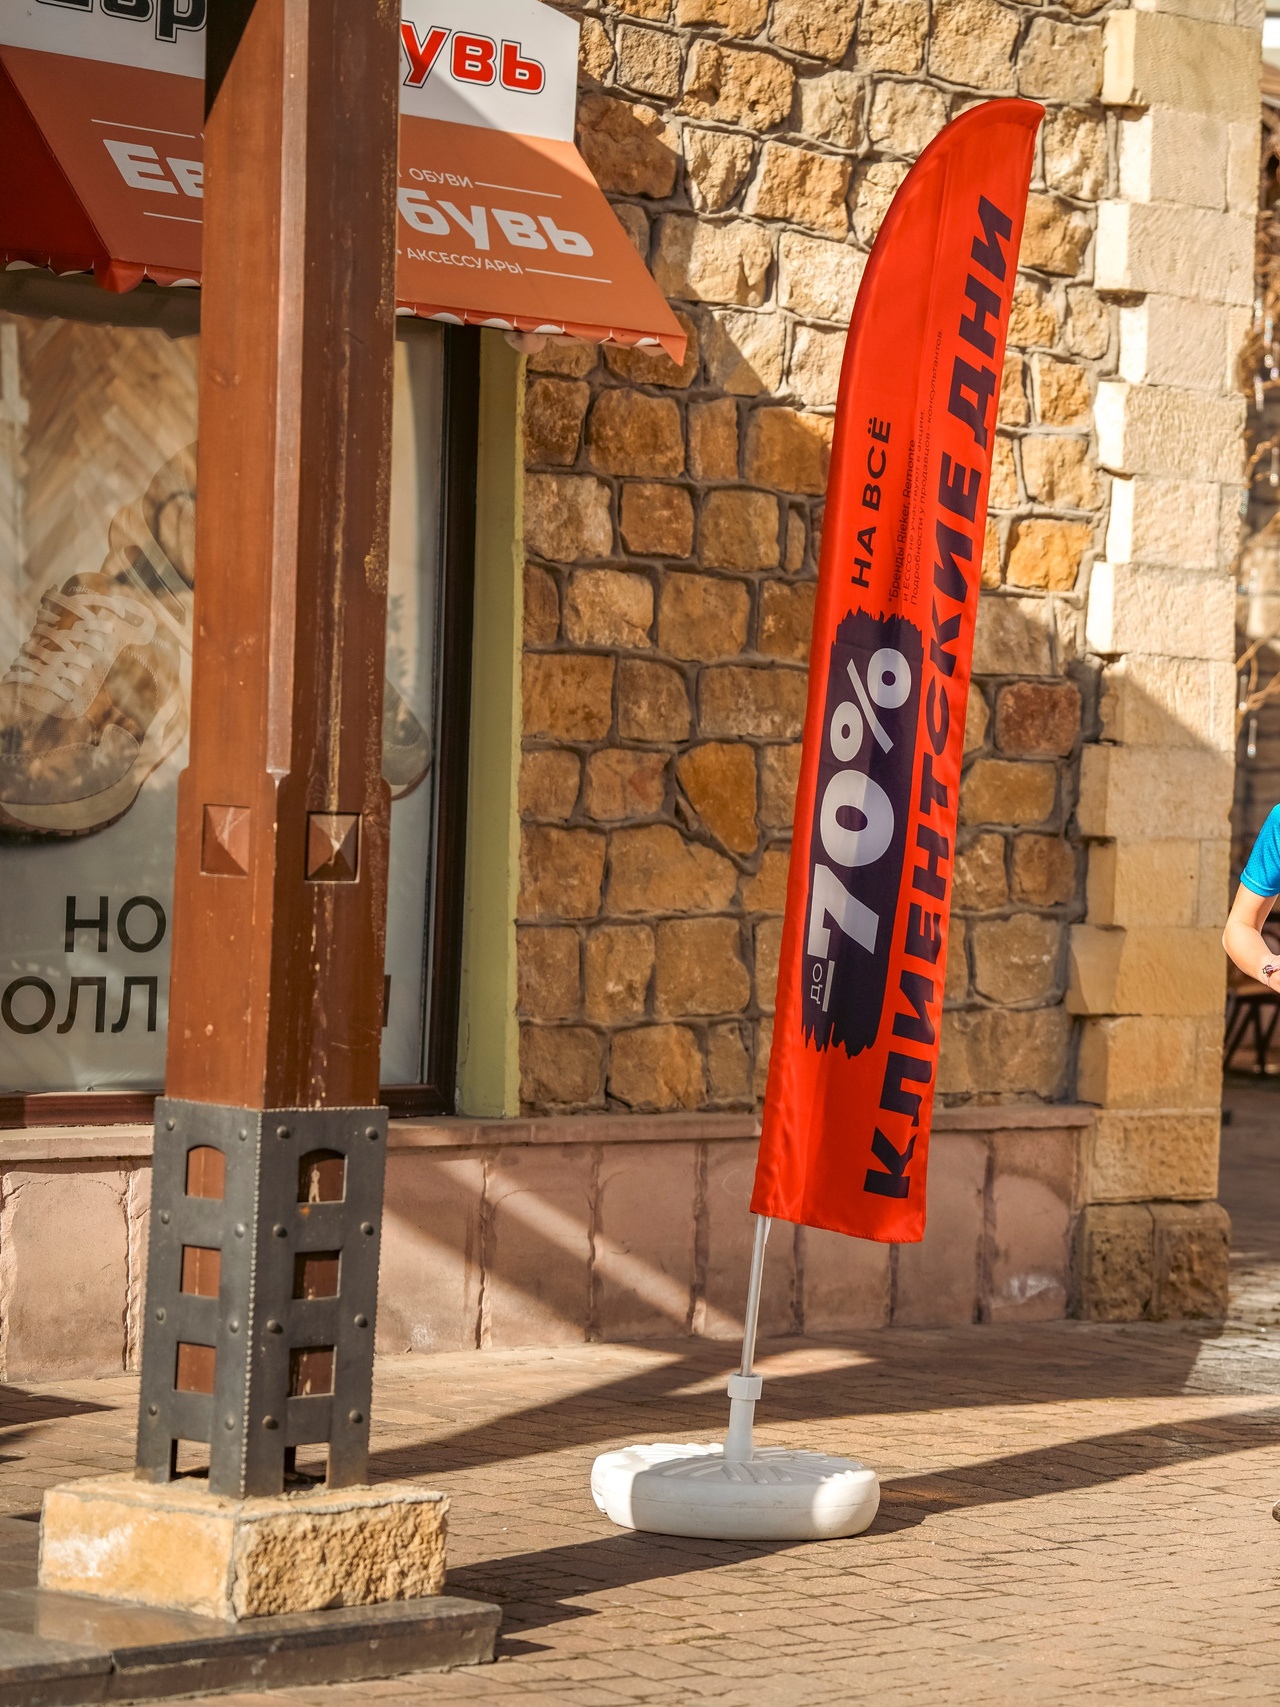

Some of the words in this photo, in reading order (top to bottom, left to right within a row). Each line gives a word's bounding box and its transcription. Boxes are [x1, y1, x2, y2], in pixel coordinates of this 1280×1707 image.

[408, 167, 474, 189] ОБУВИ
[406, 247, 524, 275] АКСЕССУАРЫ
[863, 416, 891, 511] ВСЁ
[902, 439, 916, 500] Remonte
[851, 525, 877, 588] НА
[863, 451, 982, 1199] КЛИЕНТСКИЕ
[946, 194, 1014, 451] ДНИ
